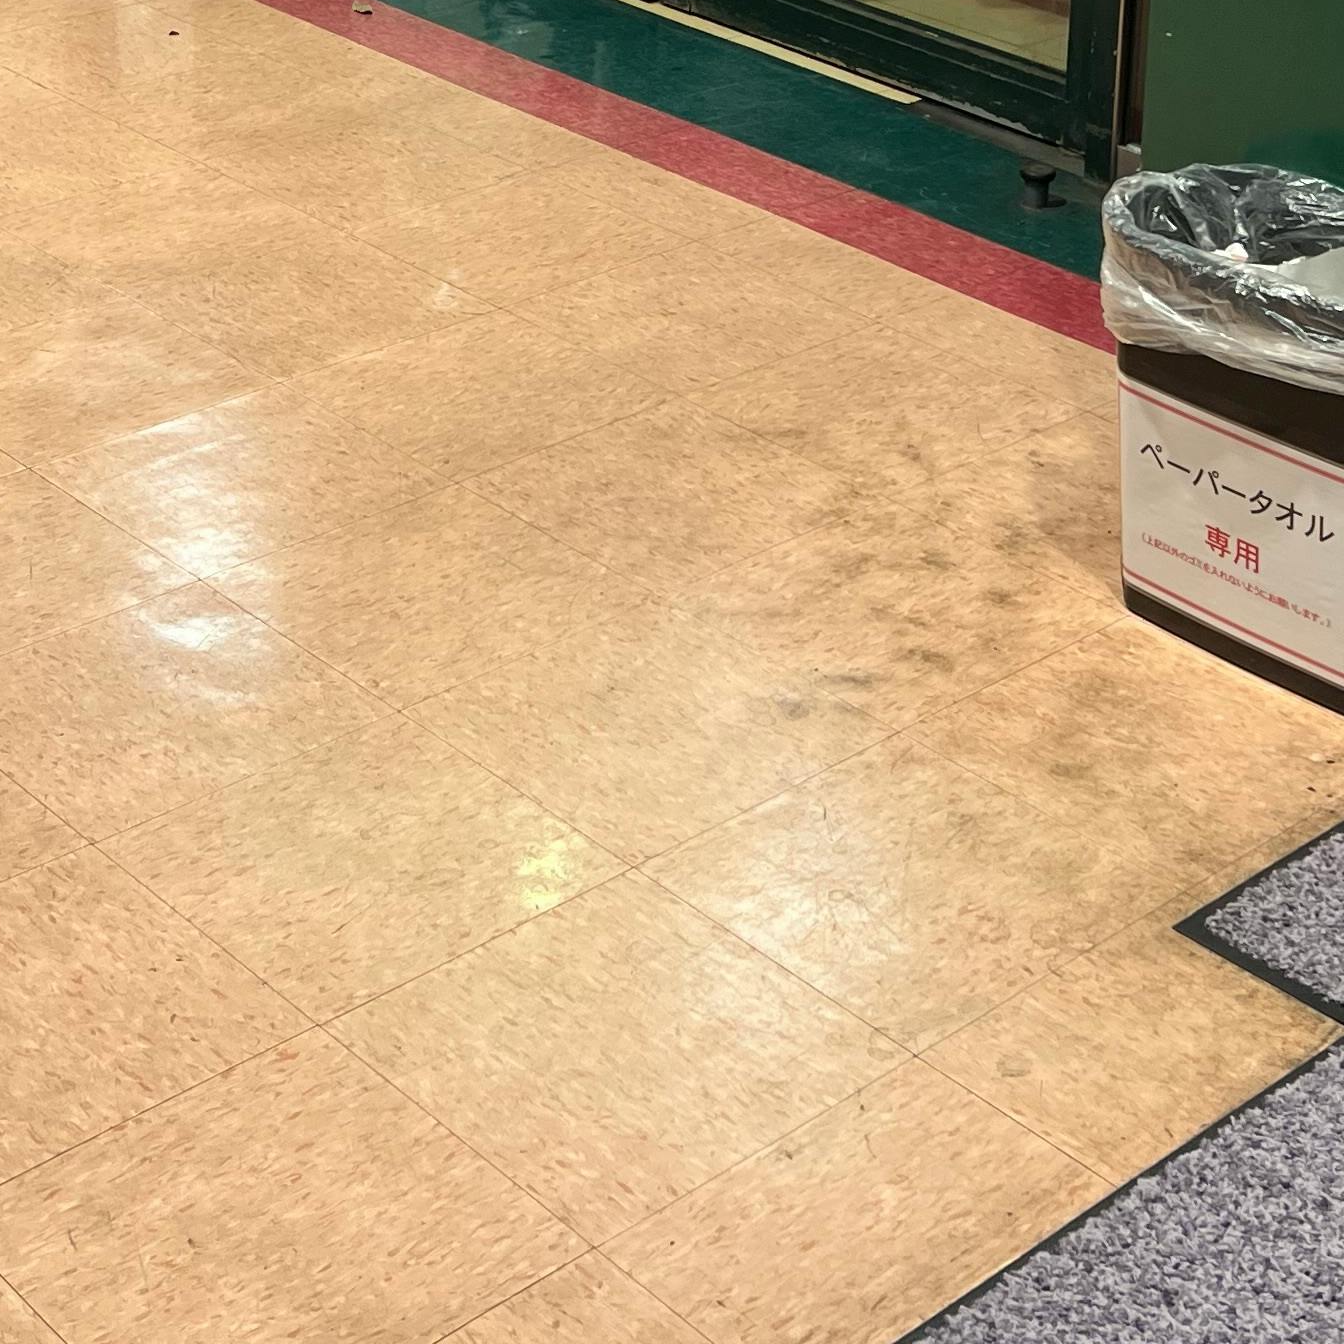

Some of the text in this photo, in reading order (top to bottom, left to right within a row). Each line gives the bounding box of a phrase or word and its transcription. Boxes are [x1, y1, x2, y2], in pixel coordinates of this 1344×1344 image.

[1140, 443, 1335, 543] ペーパータオル
[1205, 523, 1260, 574] 専用
